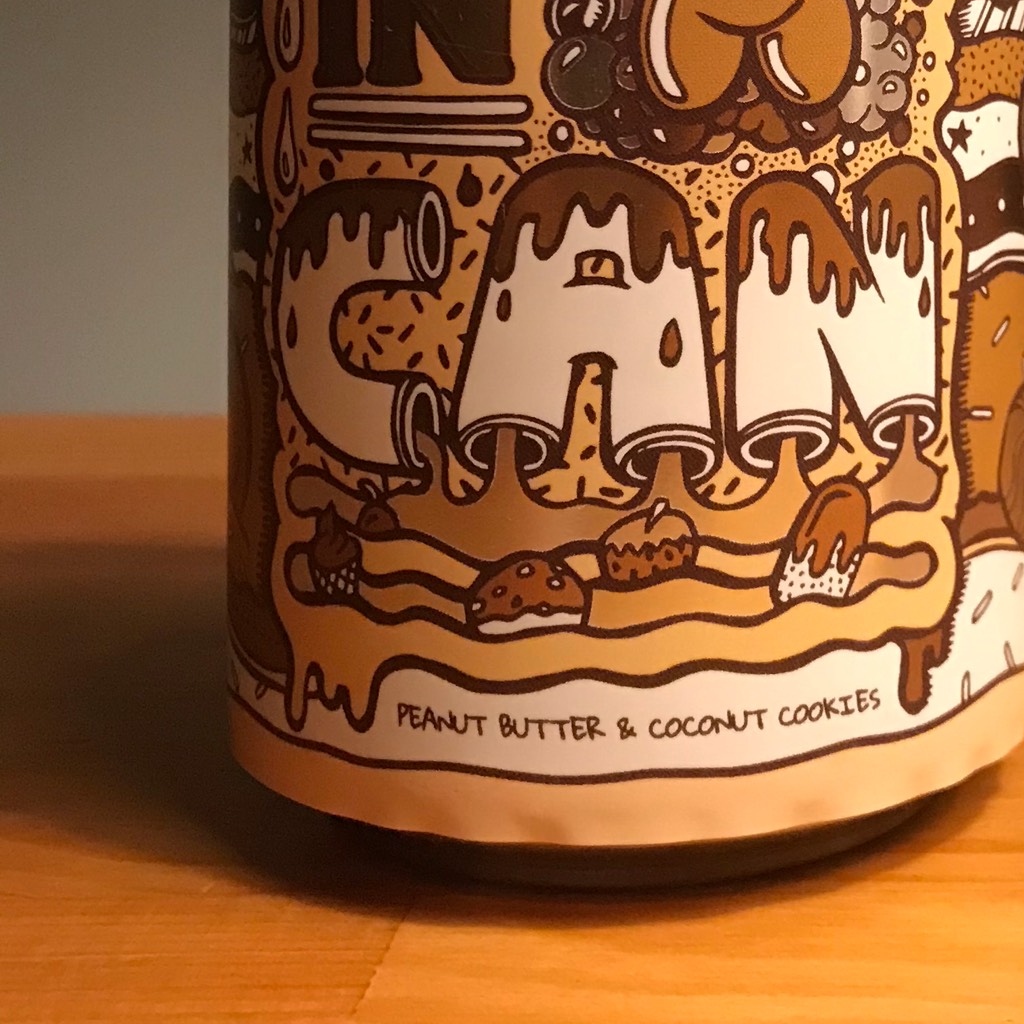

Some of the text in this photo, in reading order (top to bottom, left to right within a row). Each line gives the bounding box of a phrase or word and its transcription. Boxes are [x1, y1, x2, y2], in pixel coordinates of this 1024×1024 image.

[275, 154, 942, 482] CAN
[397, 687, 881, 741] PEANUT BUTTER & COCONUT COOKIES
